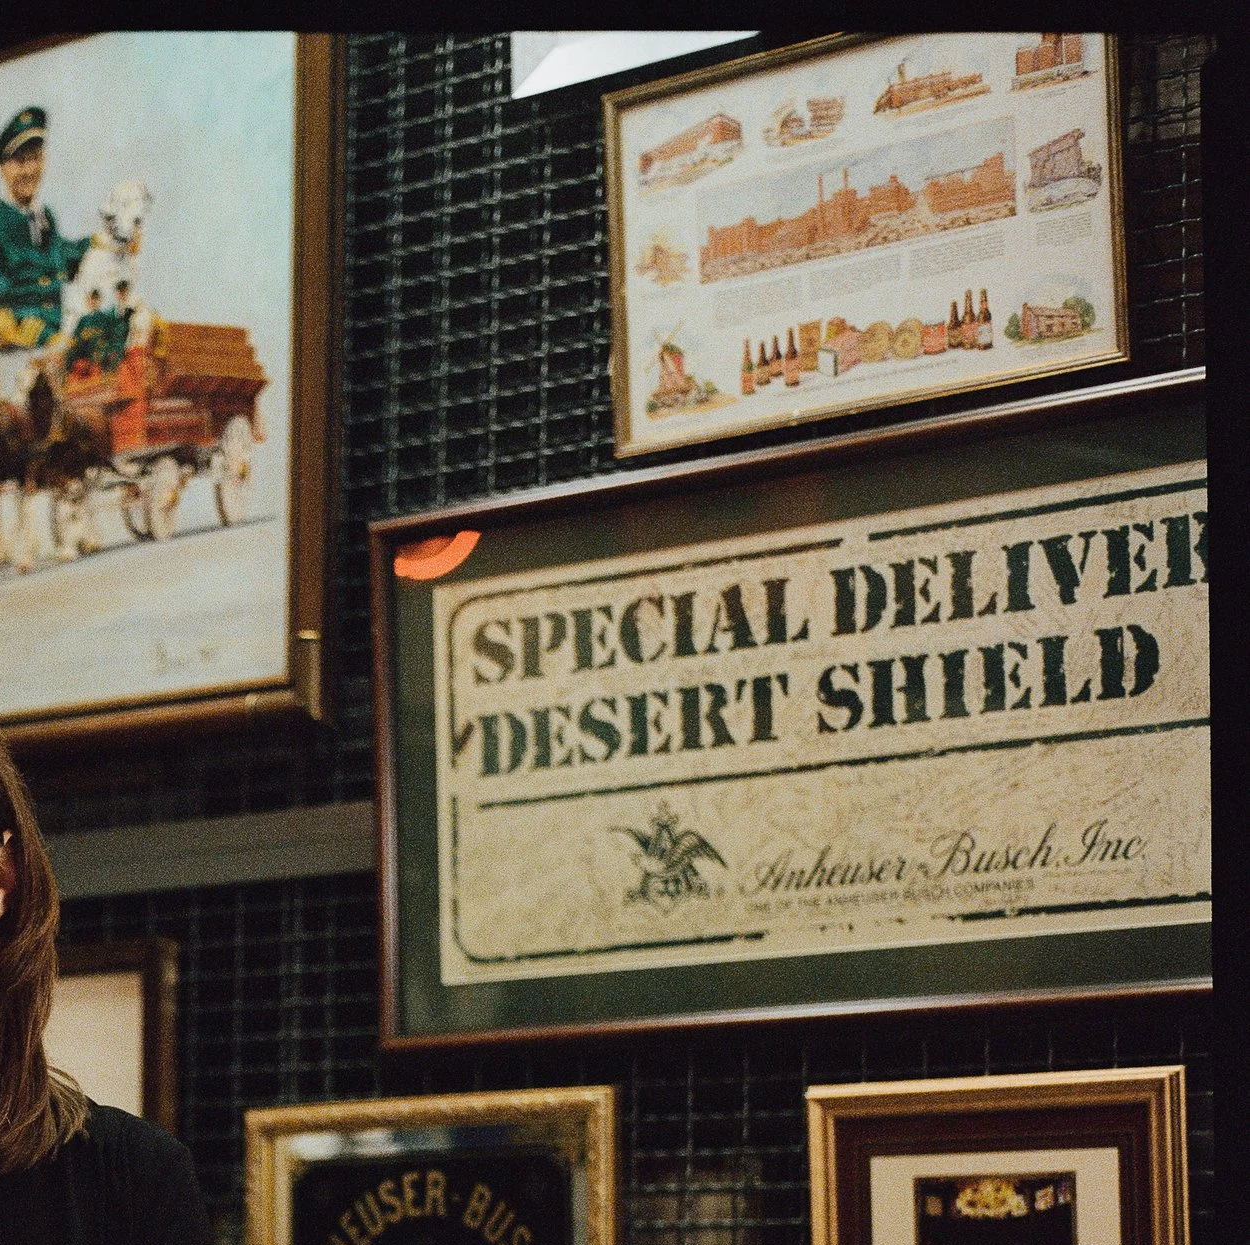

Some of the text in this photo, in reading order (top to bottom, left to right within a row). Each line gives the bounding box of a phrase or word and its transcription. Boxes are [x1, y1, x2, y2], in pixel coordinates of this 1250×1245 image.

[472, 577, 810, 686] SPECIAL
[475, 624, 1162, 778] DESERT SHIELD
